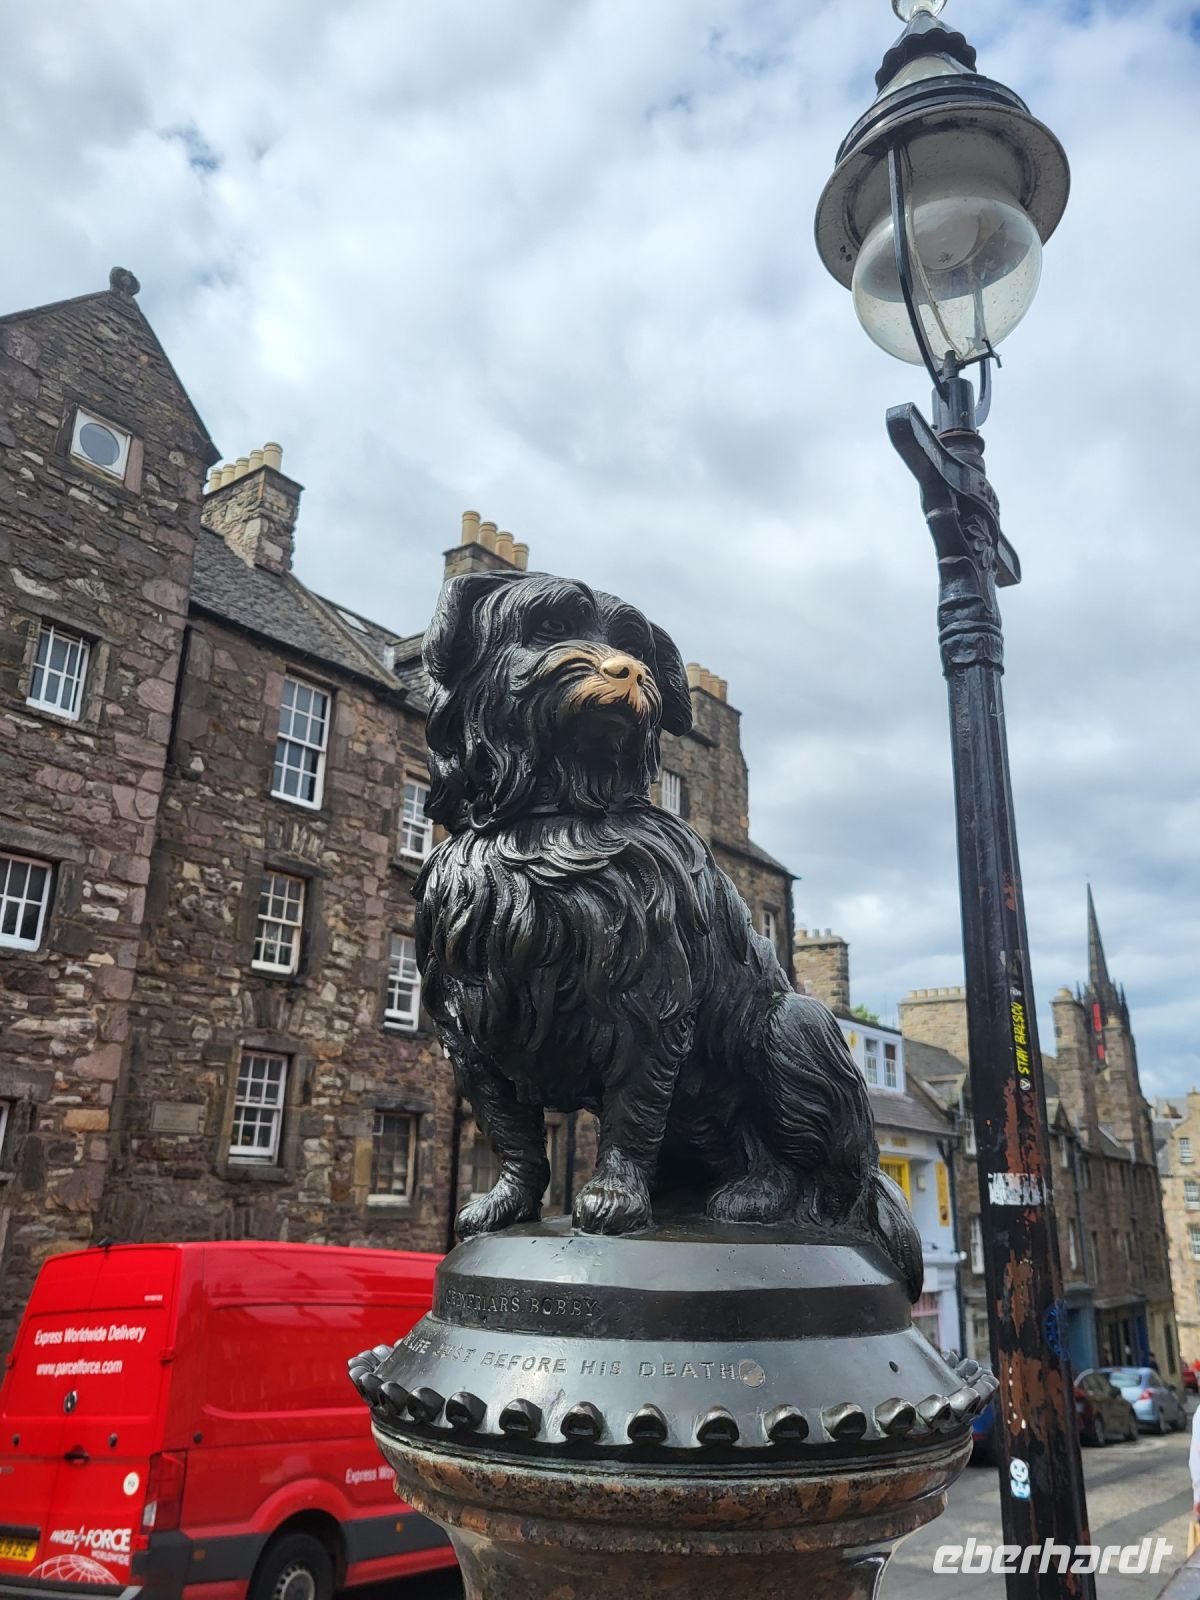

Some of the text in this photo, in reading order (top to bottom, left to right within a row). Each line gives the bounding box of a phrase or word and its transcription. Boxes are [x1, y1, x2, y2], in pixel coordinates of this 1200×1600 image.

[1015, 1046, 1030, 1075] STAY
[34, 1324, 147, 1347] Express Worldwide Delivery
[36, 1358, 123, 1378] www.parcelforce.com
[480, 1351, 567, 1374] BEFORE
[580, 1360, 623, 1376] HIS
[85, 1528, 132, 1552] FORCE
